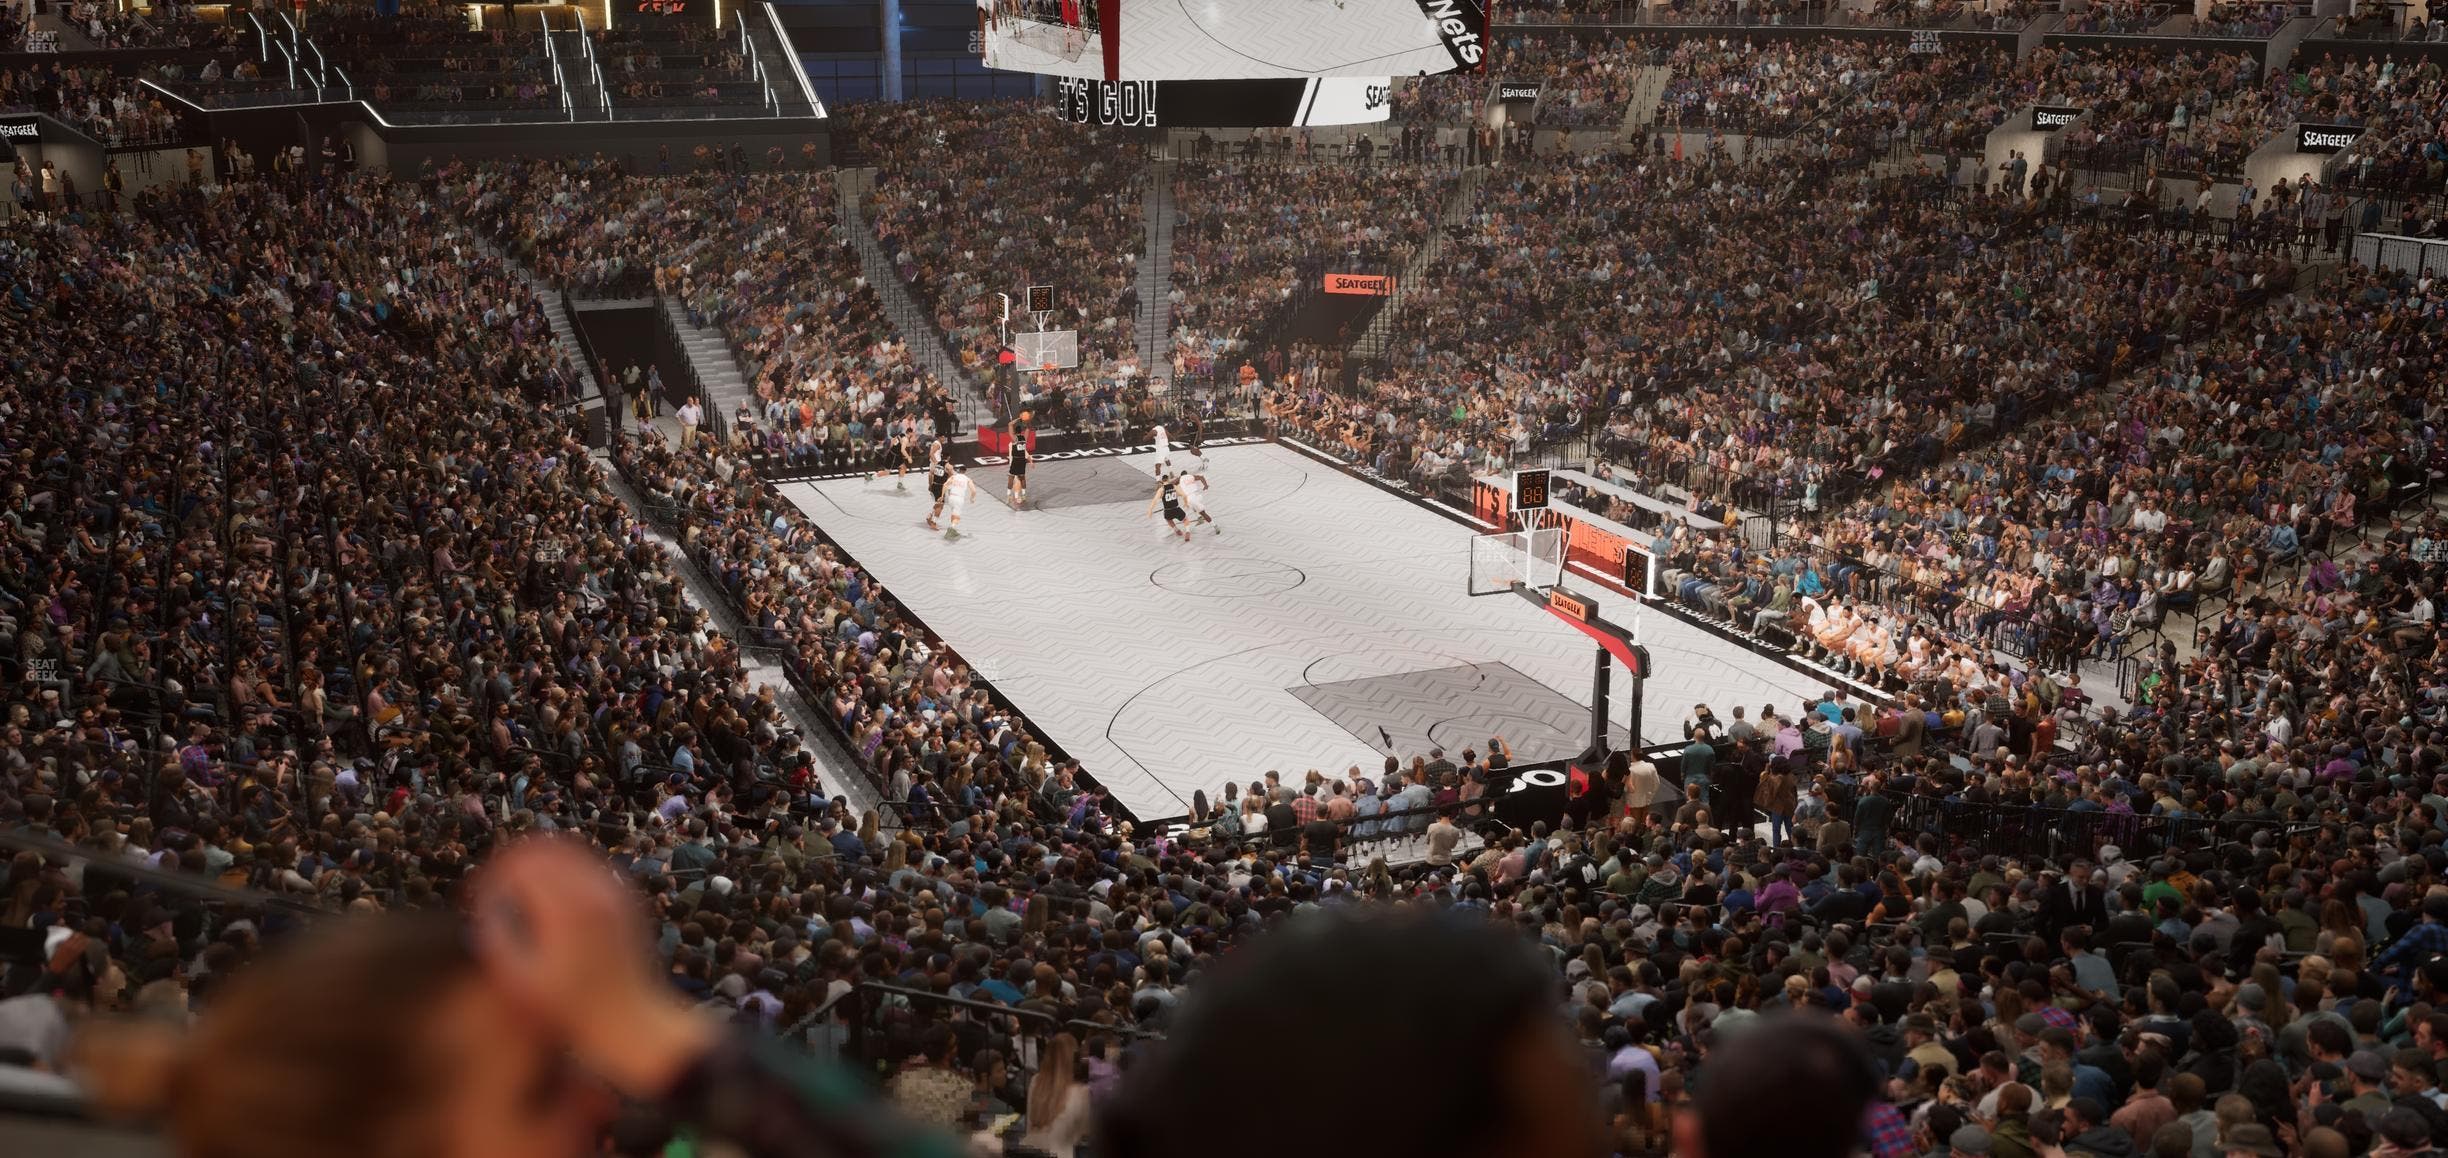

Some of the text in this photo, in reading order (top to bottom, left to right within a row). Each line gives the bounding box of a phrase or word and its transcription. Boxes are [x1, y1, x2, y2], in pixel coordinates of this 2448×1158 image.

[1426, 0, 1484, 64] Nets
[1058, 76, 1156, 127] T'S GO!
[1501, 87, 1538, 98] SEATGEEK
[2303, 130, 2356, 148] SEATGEEK
[974, 446, 1158, 465] Booklyn
[1554, 595, 1582, 616] SEATGEEK
